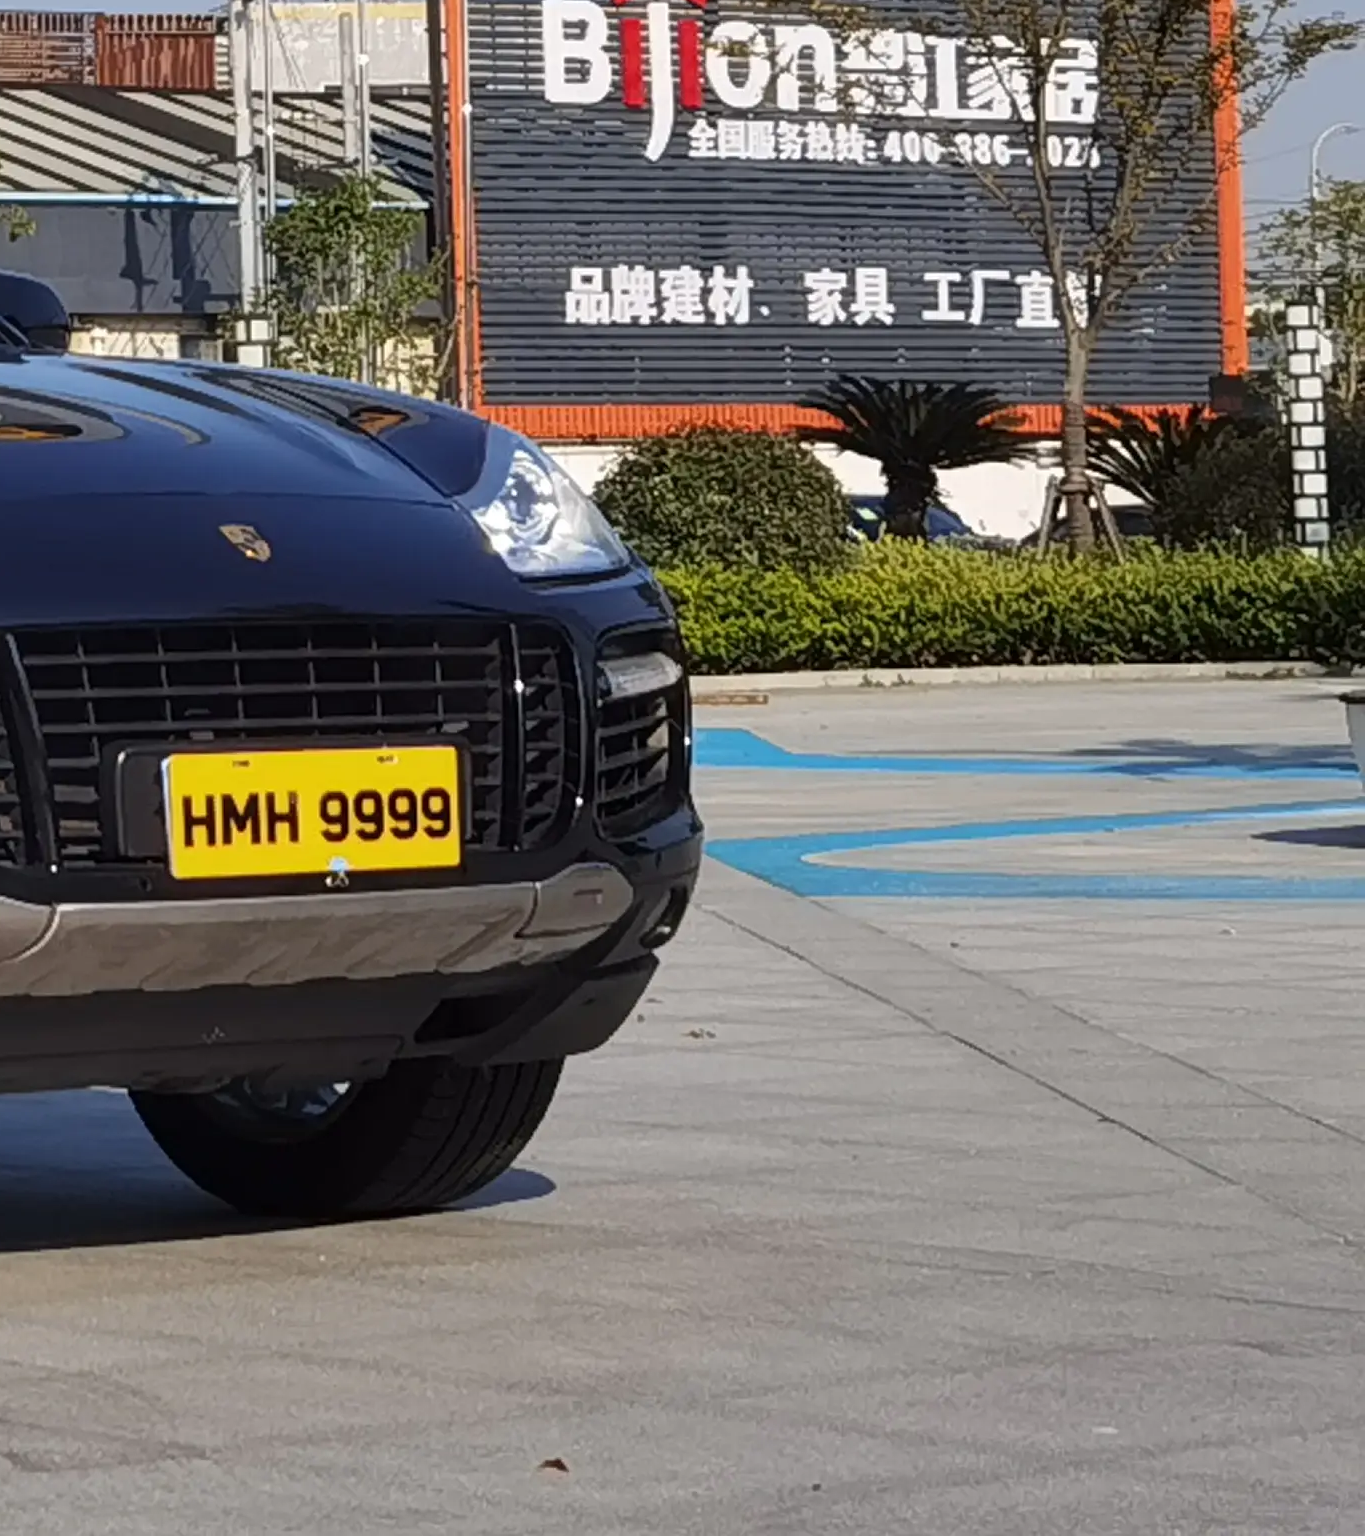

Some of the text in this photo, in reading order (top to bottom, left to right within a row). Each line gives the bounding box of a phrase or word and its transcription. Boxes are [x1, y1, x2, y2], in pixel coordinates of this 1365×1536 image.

[804, 267, 895, 326] 家具
[181, 787, 452, 848] HMH 9999
